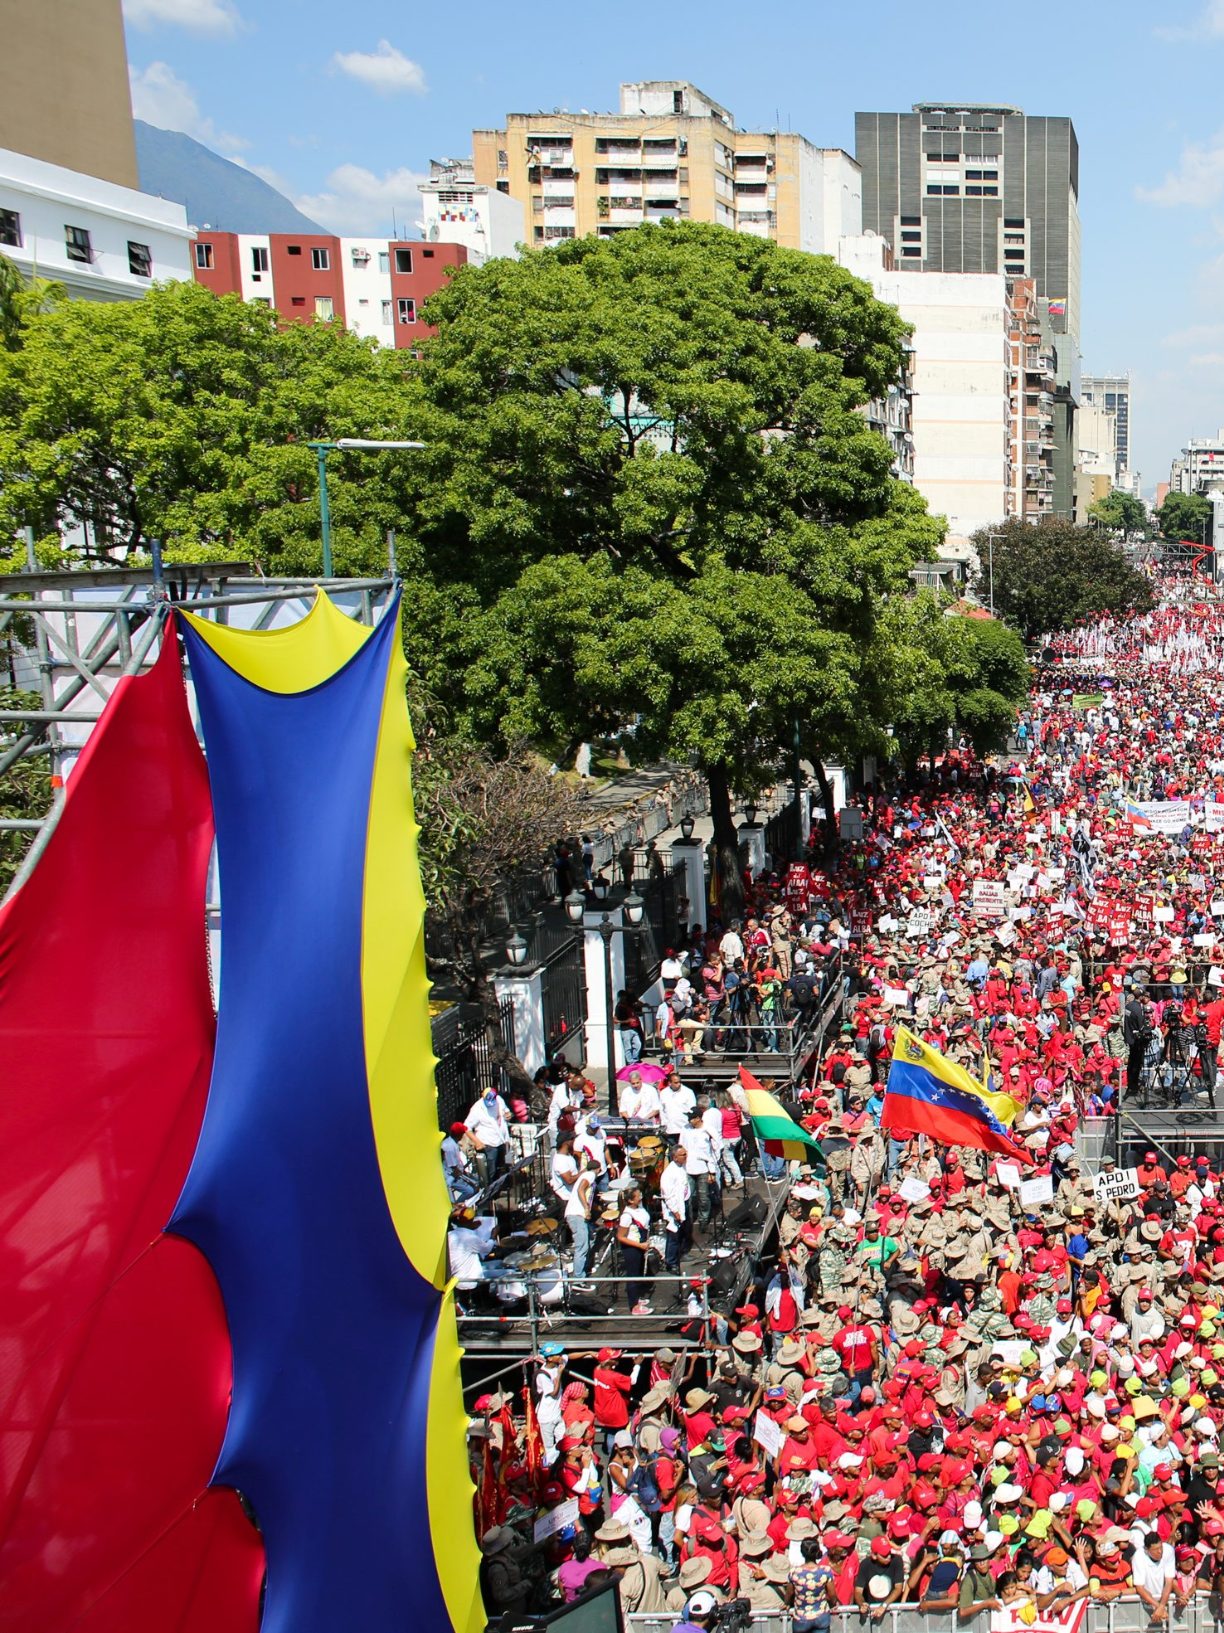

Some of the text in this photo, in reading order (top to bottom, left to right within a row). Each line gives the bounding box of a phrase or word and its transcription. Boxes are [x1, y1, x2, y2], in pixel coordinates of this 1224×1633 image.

[793, 903, 808, 912] LBA
[909, 919, 935, 928] COCHE
[1106, 1183, 1136, 1199] PEDRO
